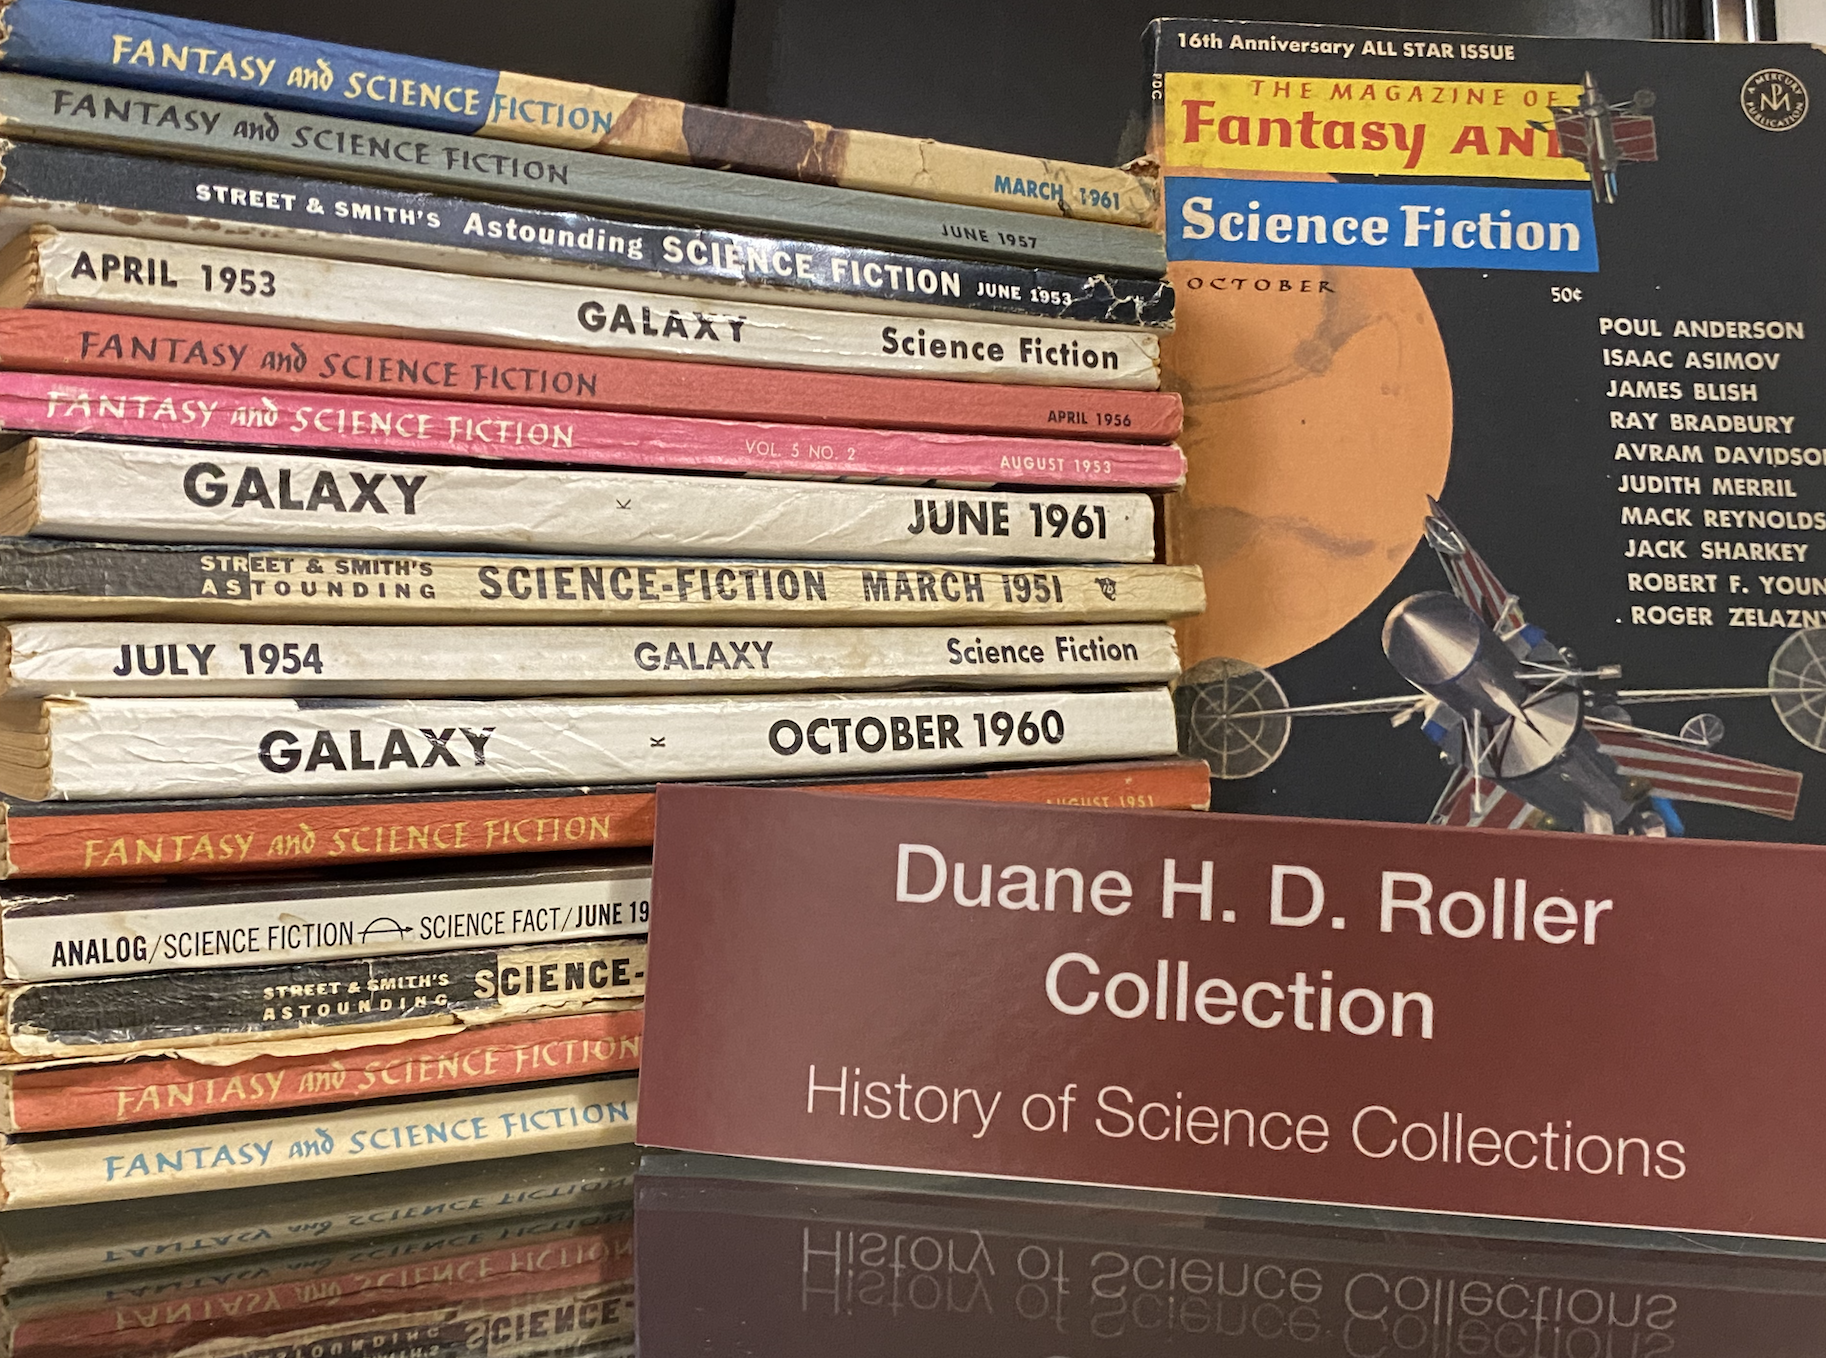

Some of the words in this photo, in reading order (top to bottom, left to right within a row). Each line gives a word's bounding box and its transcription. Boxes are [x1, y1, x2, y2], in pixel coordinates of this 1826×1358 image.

[1177, 32, 1224, 51] 16th
[1229, 35, 1355, 59] Anniversary
[1362, 40, 1398, 57] ALL
[1402, 41, 1456, 60] STAR
[1459, 43, 1516, 61] ISSUE
[111, 34, 276, 86] FANTASY
[288, 58, 334, 92] and
[344, 71, 480, 116] SCIENCE
[491, 93, 612, 135] FICTION
[1252, 79, 1315, 100] THE
[1329, 84, 1506, 107] MAGAZINE
[1523, 89, 1560, 107] OF
[1746, 102, 1804, 127] PUBLICATION
[51, 89, 221, 136] FANTASY
[234, 113, 280, 143] and
[291, 126, 430, 166] SCIENCE
[443, 146, 568, 186] FICTION
[1181, 99, 1427, 169] Fantasy
[994, 175, 1064, 201] MARCH
[1079, 185, 1120, 210] 1961
[941, 223, 988, 243] JUNE
[997, 231, 1037, 249] 1957
[1182, 196, 1389, 246] Science
[1400, 205, 1581, 252] Fiction
[195, 184, 297, 212] STREET
[306, 197, 325, 216] &
[334, 201, 441, 228] SMITH'S
[463, 212, 643, 260] Astounding
[662, 235, 813, 279] SCIENCE
[831, 258, 961, 297] FICTION
[976, 281, 1021, 300] JUNE
[1030, 287, 1072, 306] 1953
[1186, 277, 1336, 294] OCTOBER
[1551, 287, 1582, 303] 50¢
[71, 251, 178, 289] APRIL
[200, 264, 276, 297] 1953
[577, 300, 747, 344] GALAXY
[882, 327, 1004, 362] Science
[1019, 337, 1119, 371] Fiction
[1599, 317, 1663, 336] POUL
[1673, 320, 1805, 340] ANDERSON
[80, 331, 247, 371] FANTASY
[261, 343, 307, 372] and
[319, 353, 458, 390] SCIENCE
[471, 363, 597, 397] FICTION
[1602, 349, 1674, 368] ISAAC
[1685, 351, 1781, 370] ASIMOV
[1606, 380, 1683, 400] JAMES
[1694, 383, 1758, 402] BLISH
[46, 390, 217, 427] FANTASY
[230, 397, 278, 428] and
[295, 408, 433, 439] SCIENCE
[445, 415, 574, 449] FICTION
[745, 439, 784, 458] VOL.
[791, 443, 800, 458] 5
[808, 444, 838, 461] NO.
[847, 445, 856, 461] 2
[1000, 456, 1064, 472] AUGUST
[1074, 457, 1112, 474] 1953
[1047, 409, 1087, 425] APRIL
[1098, 412, 1132, 427] 1956
[1610, 411, 1658, 430] RAY
[1670, 413, 1796, 435] BRADBURY
[1614, 443, 1704, 463] AVRAM
[1715, 446, 1826, 467] DAVIDSO
[183, 462, 427, 516] GALAXY
[907, 498, 1010, 537] JUNE
[1029, 502, 1107, 538] 1961
[1617, 475, 1701, 495] JUDITH
[1712, 478, 1798, 498] MERRIL
[1620, 507, 1693, 527] MACK
[1703, 510, 1826, 531] REYNOLDS
[1624, 539, 1688, 559] JACK
[1701, 541, 1808, 563] SHARKEY
[200, 555, 294, 573] STREET
[306, 558, 323, 573] &
[335, 559, 433, 577] SMITH'S
[201, 578, 435, 599] ASTOUNDING
[477, 564, 827, 601] SCIENCE-FICTION
[862, 570, 985, 603] MARCH
[1002, 574, 1063, 603] 1951
[1627, 573, 1717, 593] ROBERT
[1729, 575, 1749, 595] F.
[1759, 576, 1826, 596] YOUN
[1631, 606, 1714, 626] ROGER
[112, 643, 216, 677] JULY
[239, 642, 324, 675] 1954
[634, 641, 773, 672] GALAXY
[947, 639, 1044, 665] Science
[1057, 636, 1139, 661] Fiction
[259, 726, 496, 773] GALAXY
[768, 713, 963, 756] OCTOBER
[973, 709, 1065, 746] 1960
[83, 833, 254, 870] FANTASY
[267, 824, 316, 857] and
[330, 823, 470, 857] SCIENCE
[484, 814, 612, 844] FICTION
[895, 842, 1133, 918] Duane
[1162, 859, 1235, 924] H.
[1270, 866, 1346, 930] D.
[1381, 872, 1613, 946] Roller
[51, 924, 260, 968] ANALOG/SCIENCE
[267, 921, 354, 951] FICTION
[420, 912, 505, 941] SCIENCE
[510, 902, 624, 934] FACT/JUNE
[630, 900, 649, 923] 19
[263, 977, 345, 1000] STREET
[347, 977, 361, 993] &
[366, 973, 450, 992] SMITH'S
[1044, 952, 1435, 1040] Collection
[263, 994, 449, 1023] ASTOUNDING
[117, 1071, 287, 1121] FANTASY
[299, 1062, 346, 1093] and
[359, 1043, 502, 1089] SCIENCE
[516, 1035, 640, 1071] FICTION
[807, 1063, 1001, 1137] History
[1022, 1083, 1077, 1133] of
[1094, 1083, 1330, 1154] Science
[1352, 1105, 1687, 1180] Collections
[105, 1140, 275, 1182] FANTASY
[289, 1129, 336, 1160] and
[349, 1116, 487, 1154] SCIENCE
[499, 1101, 631, 1140] FICTION
